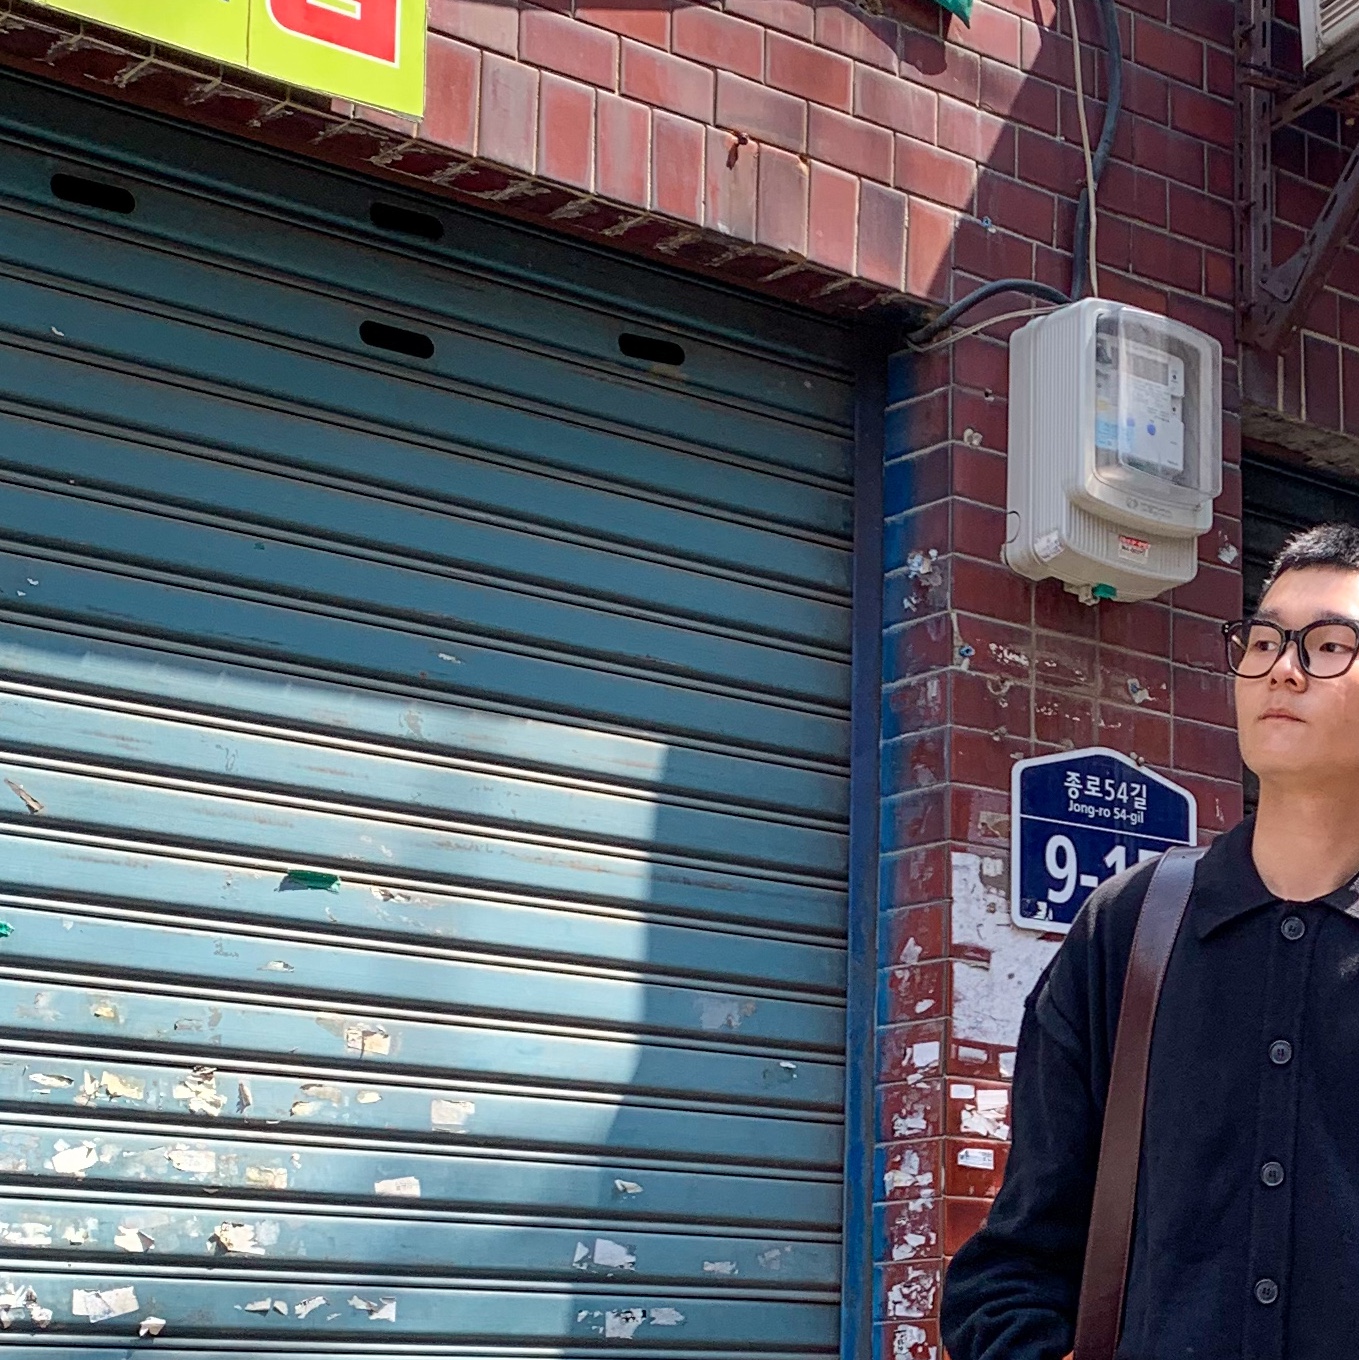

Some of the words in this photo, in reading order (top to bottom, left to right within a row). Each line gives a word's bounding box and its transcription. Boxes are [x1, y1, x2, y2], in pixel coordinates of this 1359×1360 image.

[1064, 771, 1147, 810] 종로54길
[1068, 800, 1111, 818] Jong-ro
[1113, 807, 1144, 824] 54-gil
[1045, 834, 1163, 904] 9-1
